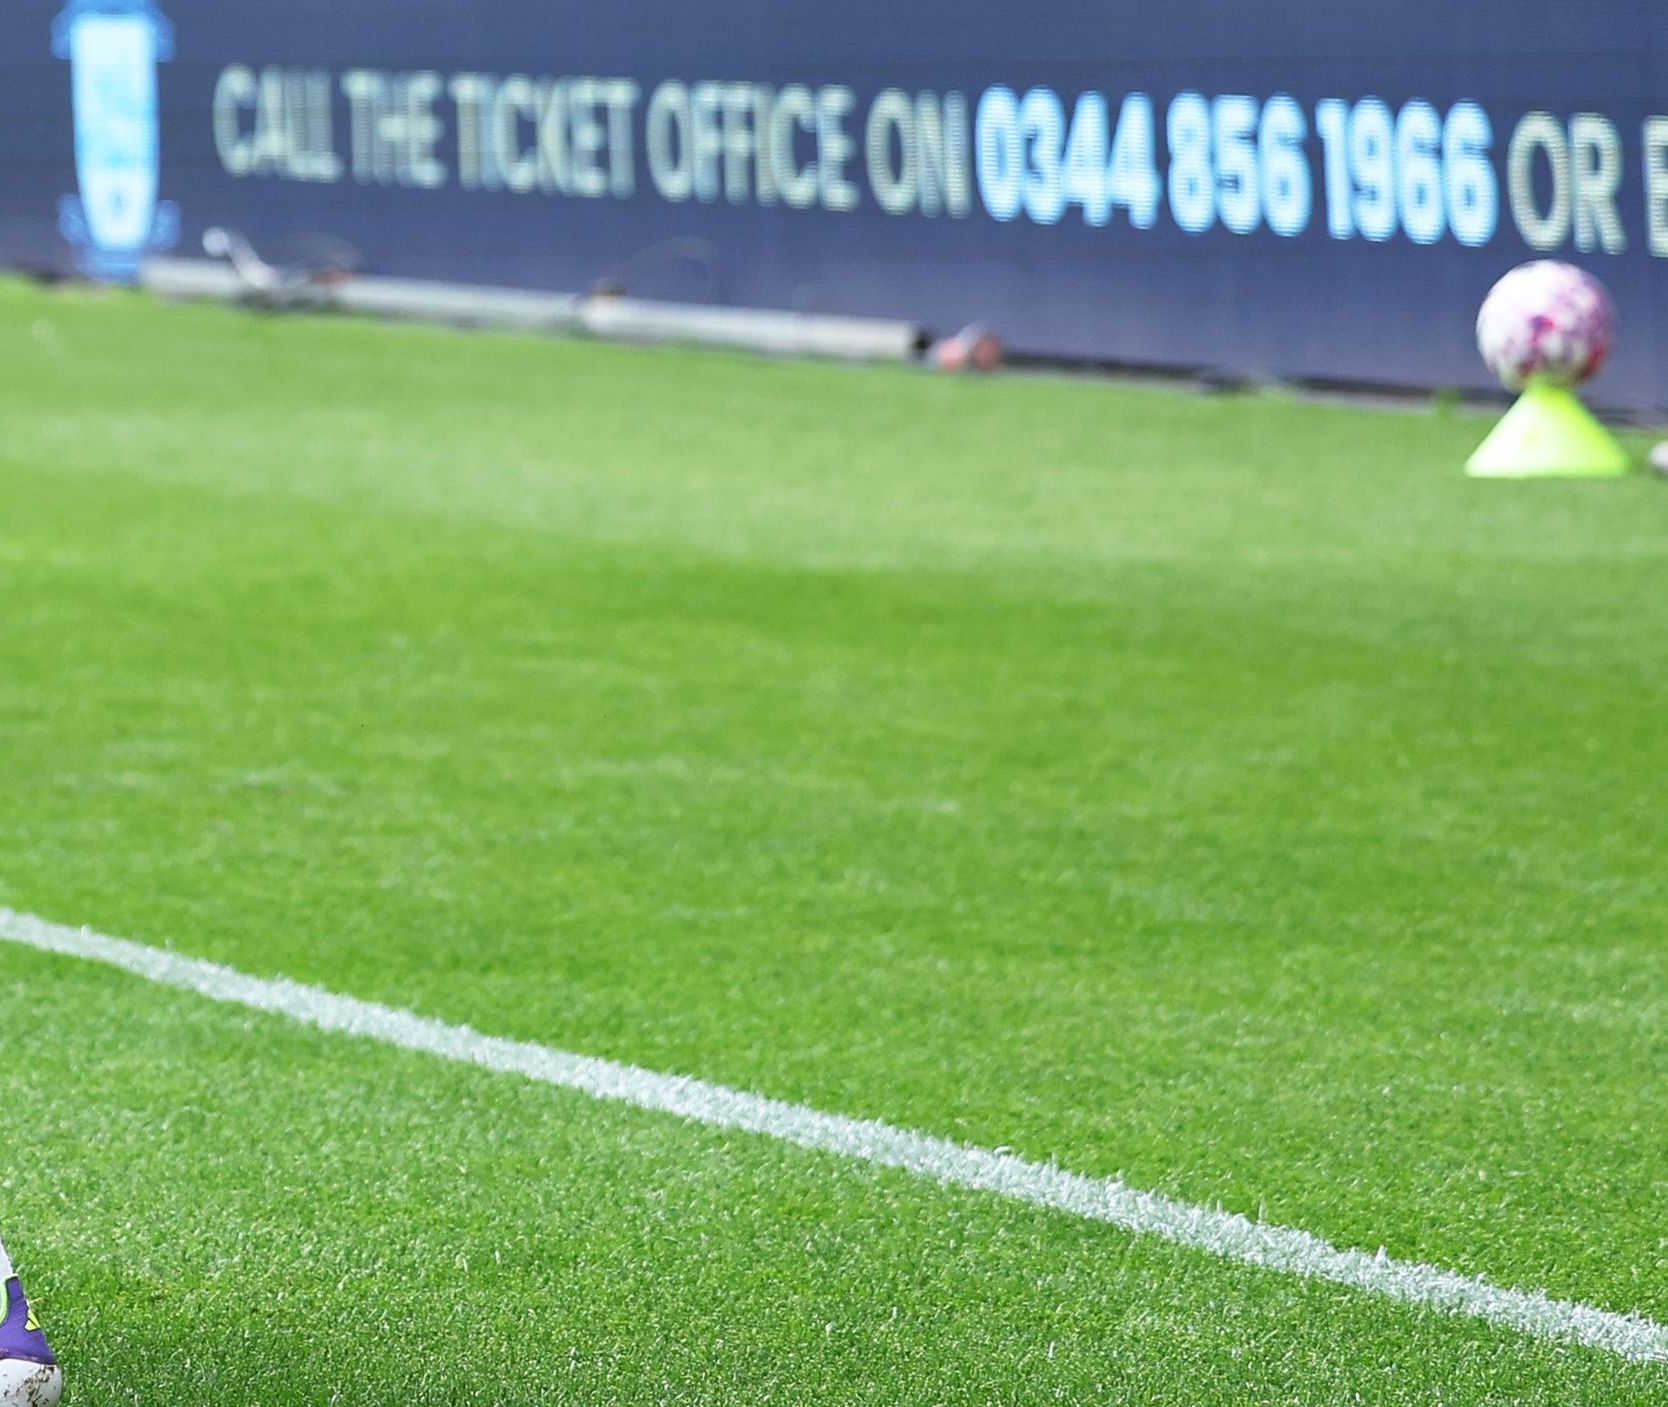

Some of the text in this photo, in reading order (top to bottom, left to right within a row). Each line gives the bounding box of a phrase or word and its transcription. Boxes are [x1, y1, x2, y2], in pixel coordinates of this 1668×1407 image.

[214, 63, 343, 183] CALL
[341, 70, 448, 189] THE
[448, 72, 639, 199] TICKET
[647, 80, 860, 213] OFFICE
[866, 86, 972, 218] ON
[975, 84, 1161, 230] 0344
[1167, 89, 1312, 237] 856
[1316, 95, 1499, 249] 1966
[1508, 110, 1628, 256] OR
